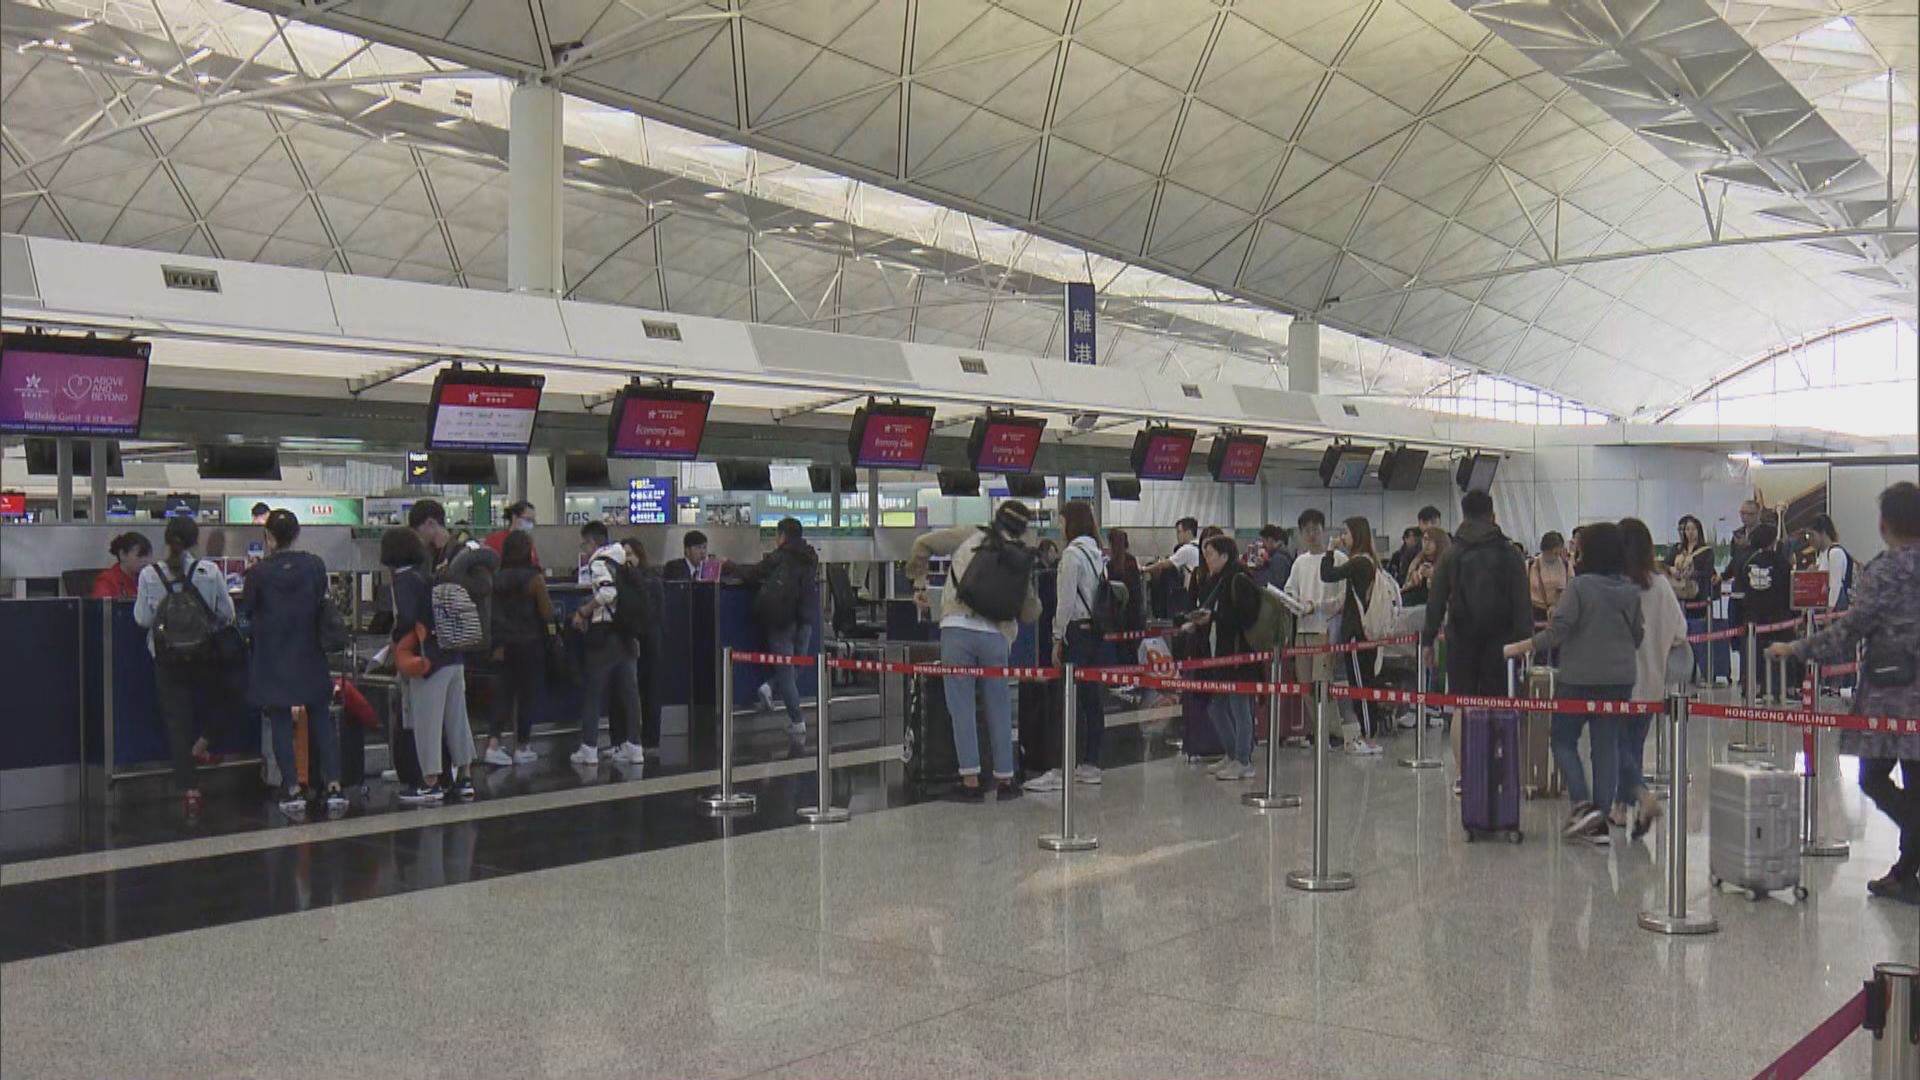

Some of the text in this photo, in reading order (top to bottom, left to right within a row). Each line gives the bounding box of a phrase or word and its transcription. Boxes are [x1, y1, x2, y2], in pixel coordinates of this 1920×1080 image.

[1073, 308, 1092, 363] 離港
[93, 376, 124, 386] ABOVE
[92, 385, 112, 393] AND
[91, 391, 128, 402] BEYOND
[1161, 680, 1236, 691] HONGKONG AIRLINES
[1456, 696, 1558, 709] HONGKONG AIRLINES
[1586, 702, 1647, 713] 香港航空
[1725, 707, 1836, 724] HONGKONG AIRLINES
